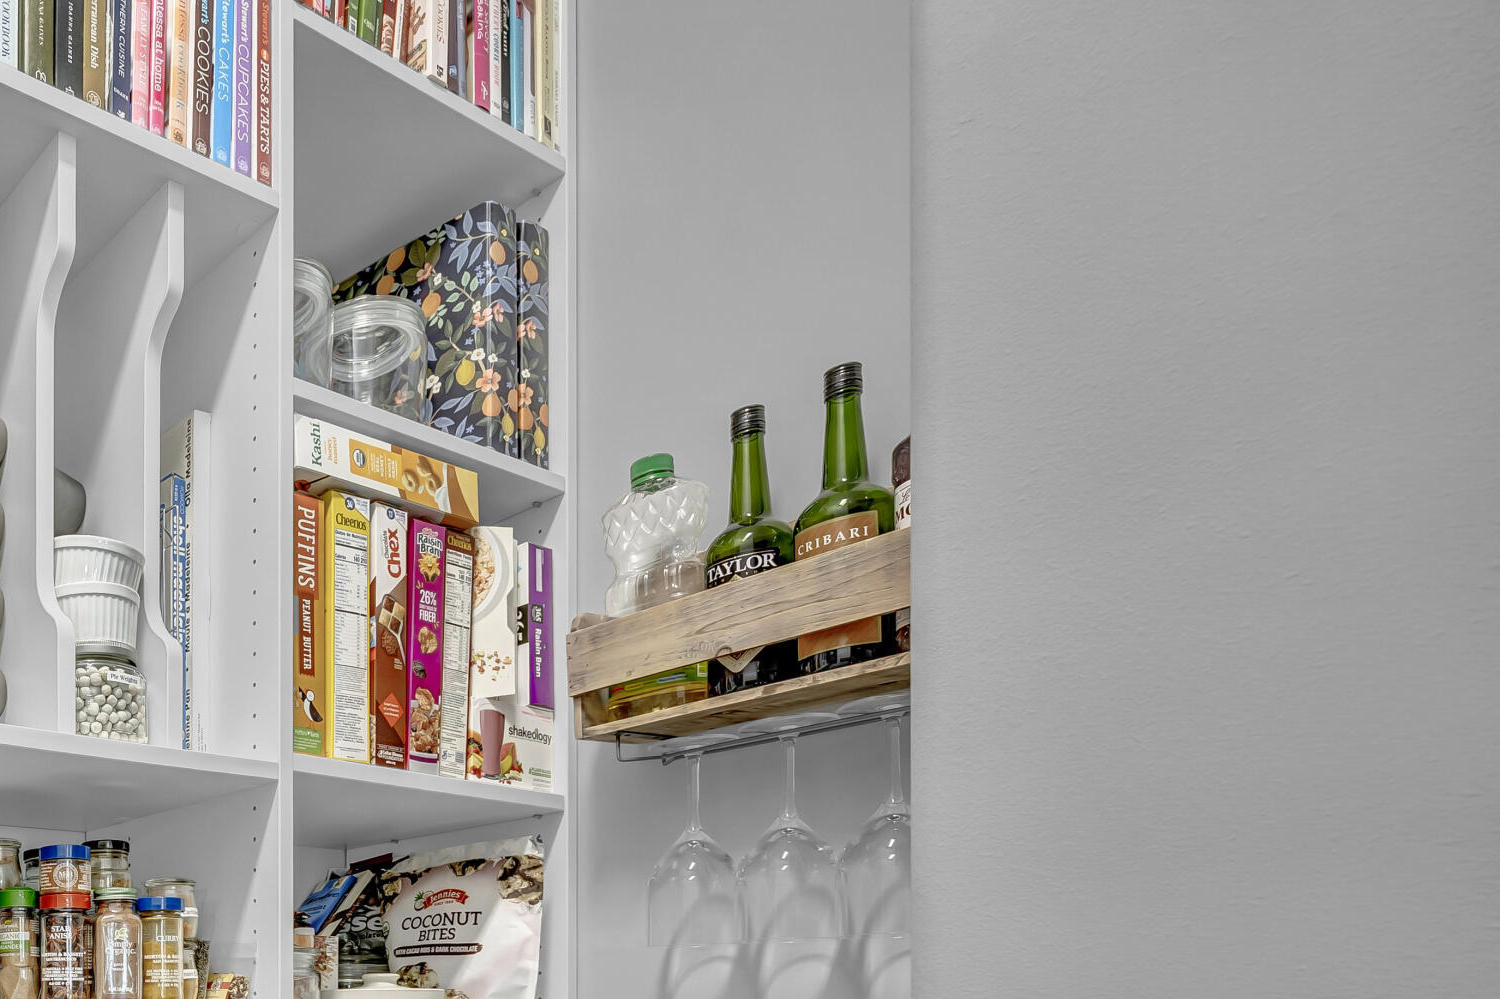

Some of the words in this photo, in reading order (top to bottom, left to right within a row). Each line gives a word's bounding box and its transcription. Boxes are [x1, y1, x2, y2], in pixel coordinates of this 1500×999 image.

[262, 2, 270, 45] Stewart's
[90, 45, 99, 69] Dish
[118, 35, 127, 78] CUISINE
[155, 40, 163, 55] at
[154, 56, 165, 92] home
[196, 26, 211, 115] COOKIES
[217, 47, 230, 102] CAKES
[259, 59, 270, 94] PIES
[236, 43, 250, 143] CUPCAKES
[259, 94, 269, 106] &
[259, 106, 270, 155] TARTS
[309, 420, 322, 467] Kashi
[335, 512, 367, 531] Cheerios
[297, 505, 316, 590] PUFFINS
[387, 528, 402, 579] Chex
[418, 532, 443, 549] Raisin
[420, 543, 440, 559] Bran
[797, 525, 870, 557] CRIBARI
[707, 552, 776, 584] TAYLOR
[419, 589, 437, 607] 26%
[301, 599, 311, 635] PEANUT
[419, 609, 437, 624] FIBER
[302, 635, 312, 671] BUTTER
[508, 725, 552, 746] shakeology
[401, 911, 482, 930] COCONUT
[418, 928, 456, 942] BITES
[450, 945, 478, 953] CHOCOLATE
